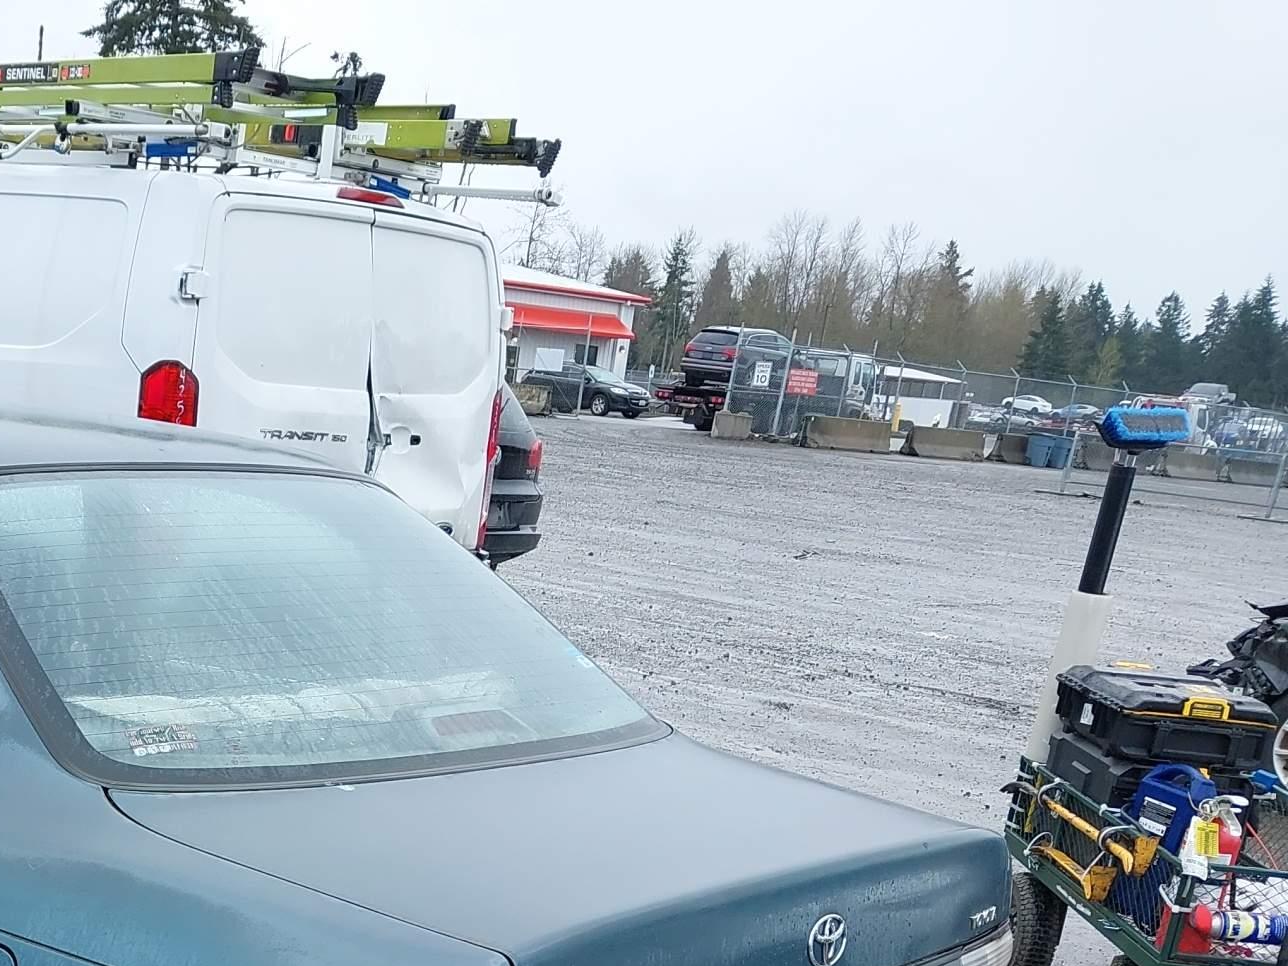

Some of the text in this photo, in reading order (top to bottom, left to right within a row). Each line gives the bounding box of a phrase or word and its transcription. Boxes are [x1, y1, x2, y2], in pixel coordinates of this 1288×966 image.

[5, 67, 46, 81] SENTINEL
[756, 374, 767, 384] 10
[259, 429, 329, 442] TRANSIT
